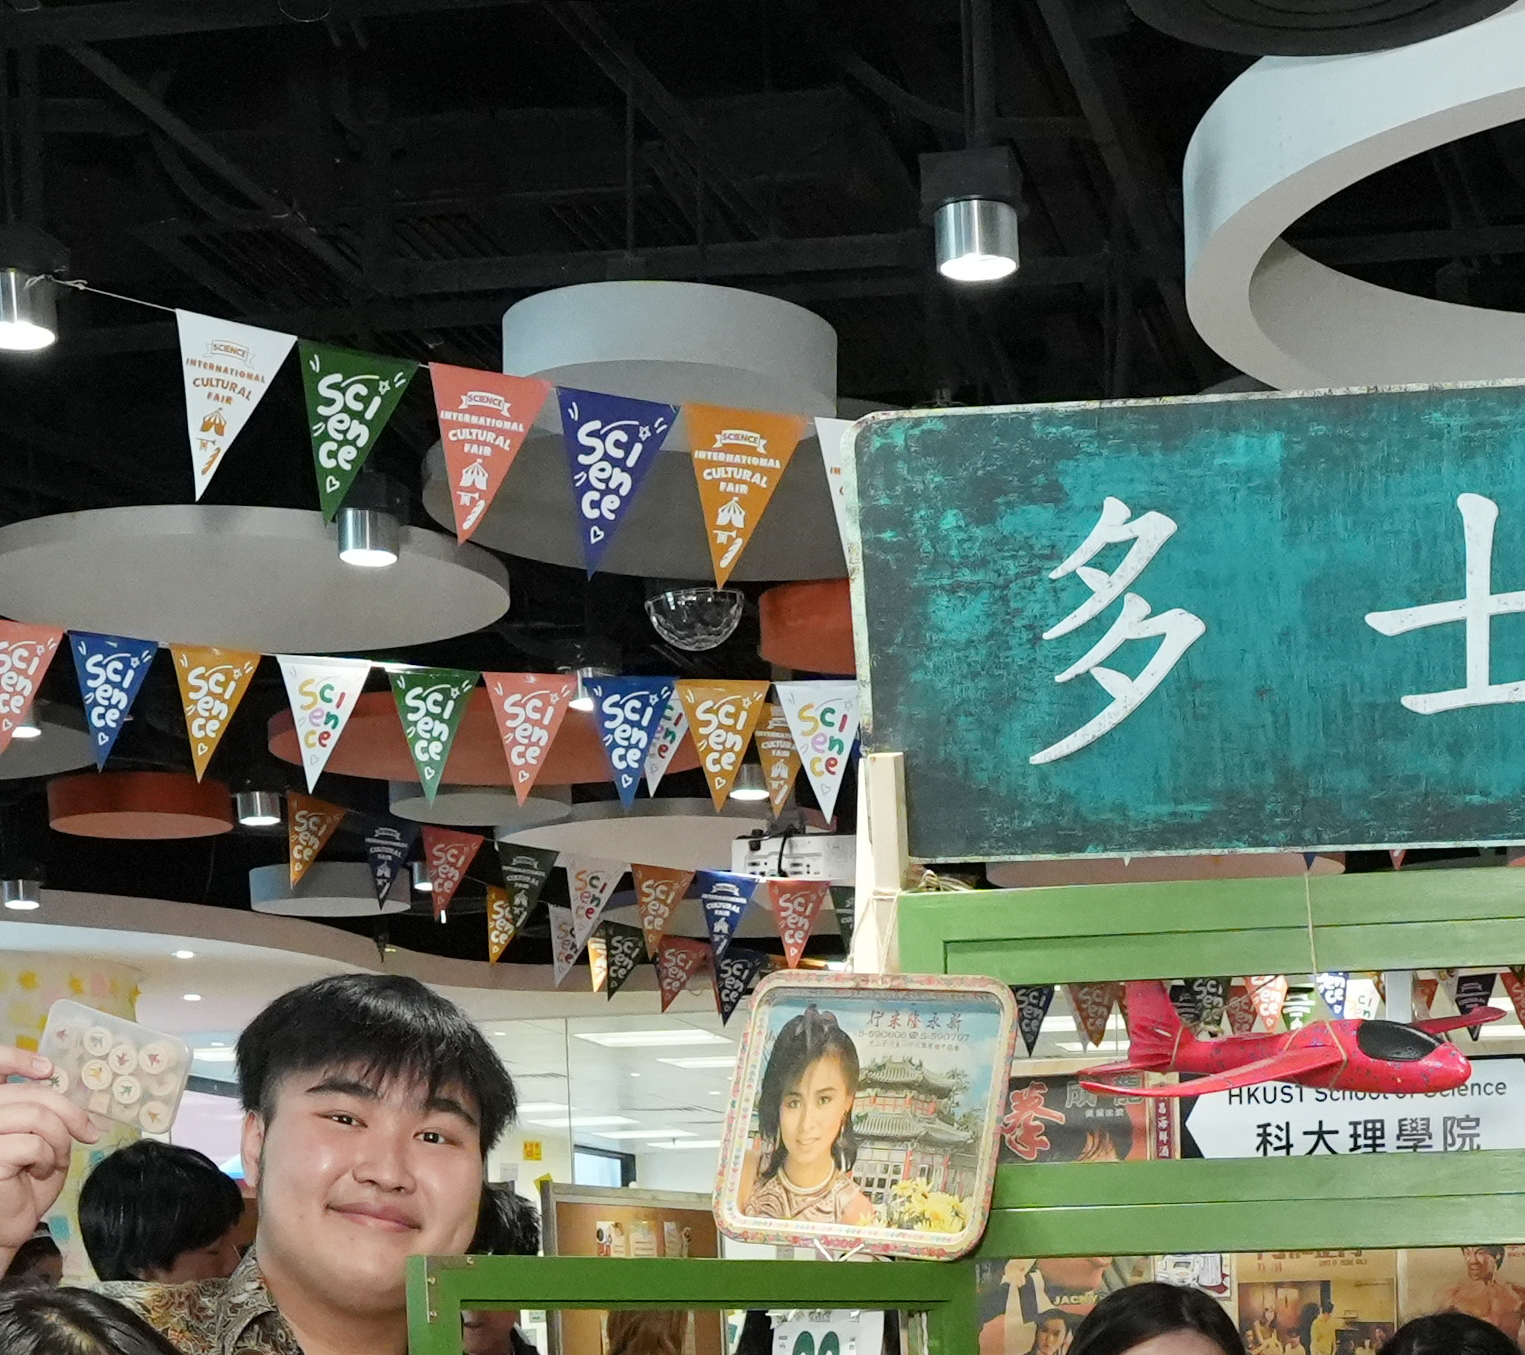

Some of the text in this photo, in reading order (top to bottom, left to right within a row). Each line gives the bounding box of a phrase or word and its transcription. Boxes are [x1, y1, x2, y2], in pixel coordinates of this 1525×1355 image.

[193, 377, 251, 401] CULTURAL
[207, 391, 233, 404] FAIR
[448, 429, 510, 452] CULTURAL
[464, 443, 491, 457] FAIR
[702, 467, 768, 488] CULTURAL
[719, 481, 748, 495] FAIR
[1228, 1084, 1306, 1106] HKUST
[1256, 1113, 1482, 1154] 科大理學院
